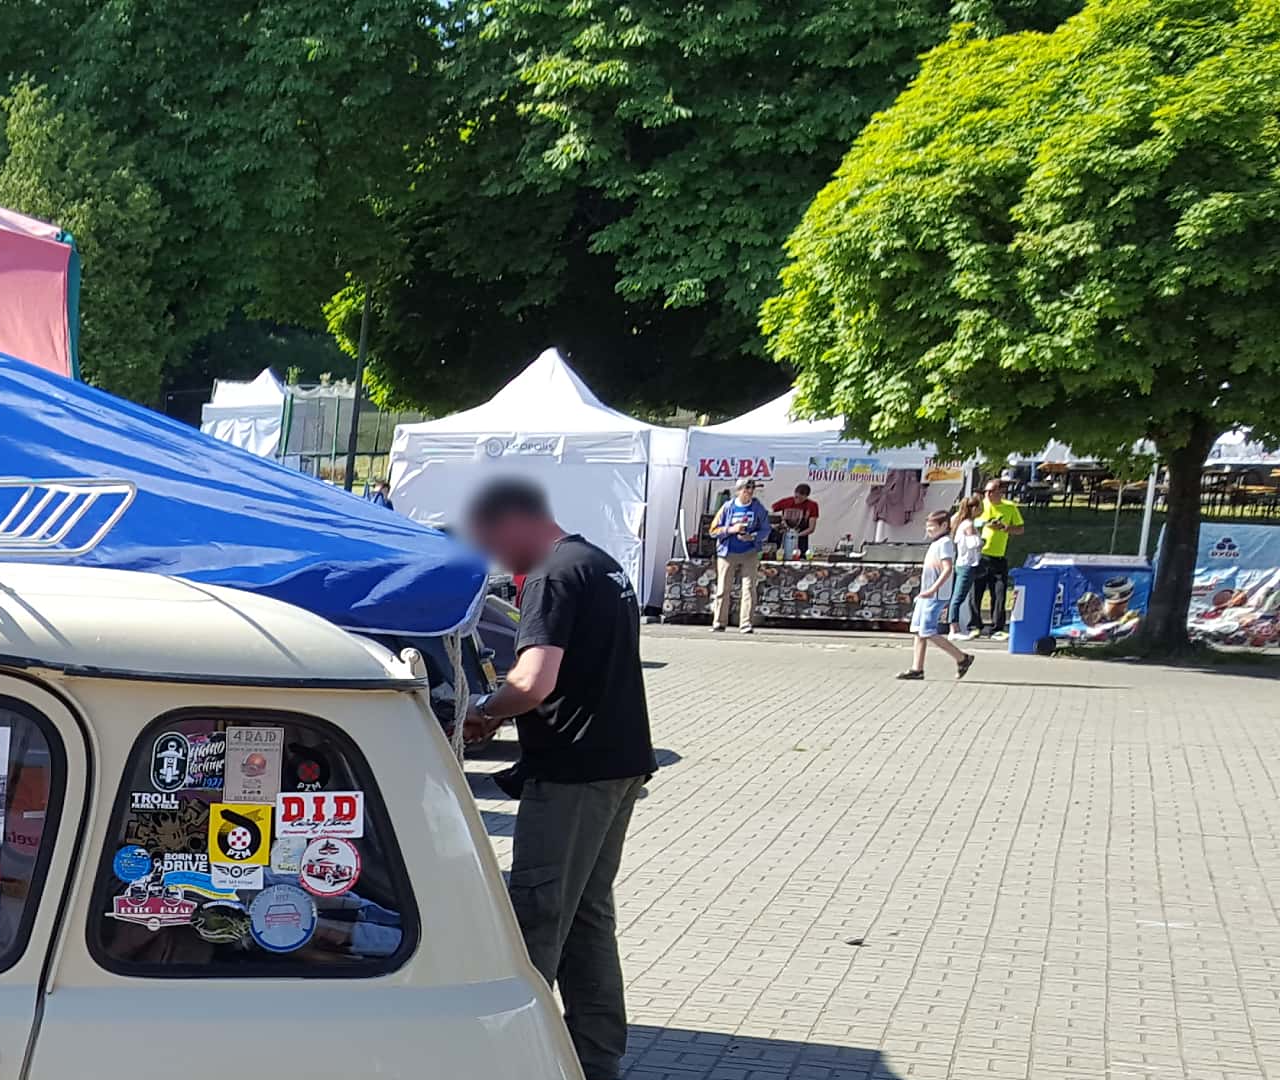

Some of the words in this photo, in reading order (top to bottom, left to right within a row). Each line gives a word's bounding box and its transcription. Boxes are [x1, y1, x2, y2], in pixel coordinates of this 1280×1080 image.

[698, 458, 773, 478] КАВА
[296, 781, 321, 792] PZM
[132, 792, 180, 804] TROLL
[164, 853, 193, 861] BORN
[195, 853, 208, 861] TO
[226, 849, 251, 860] PZM
[163, 861, 208, 872] DRIVE
